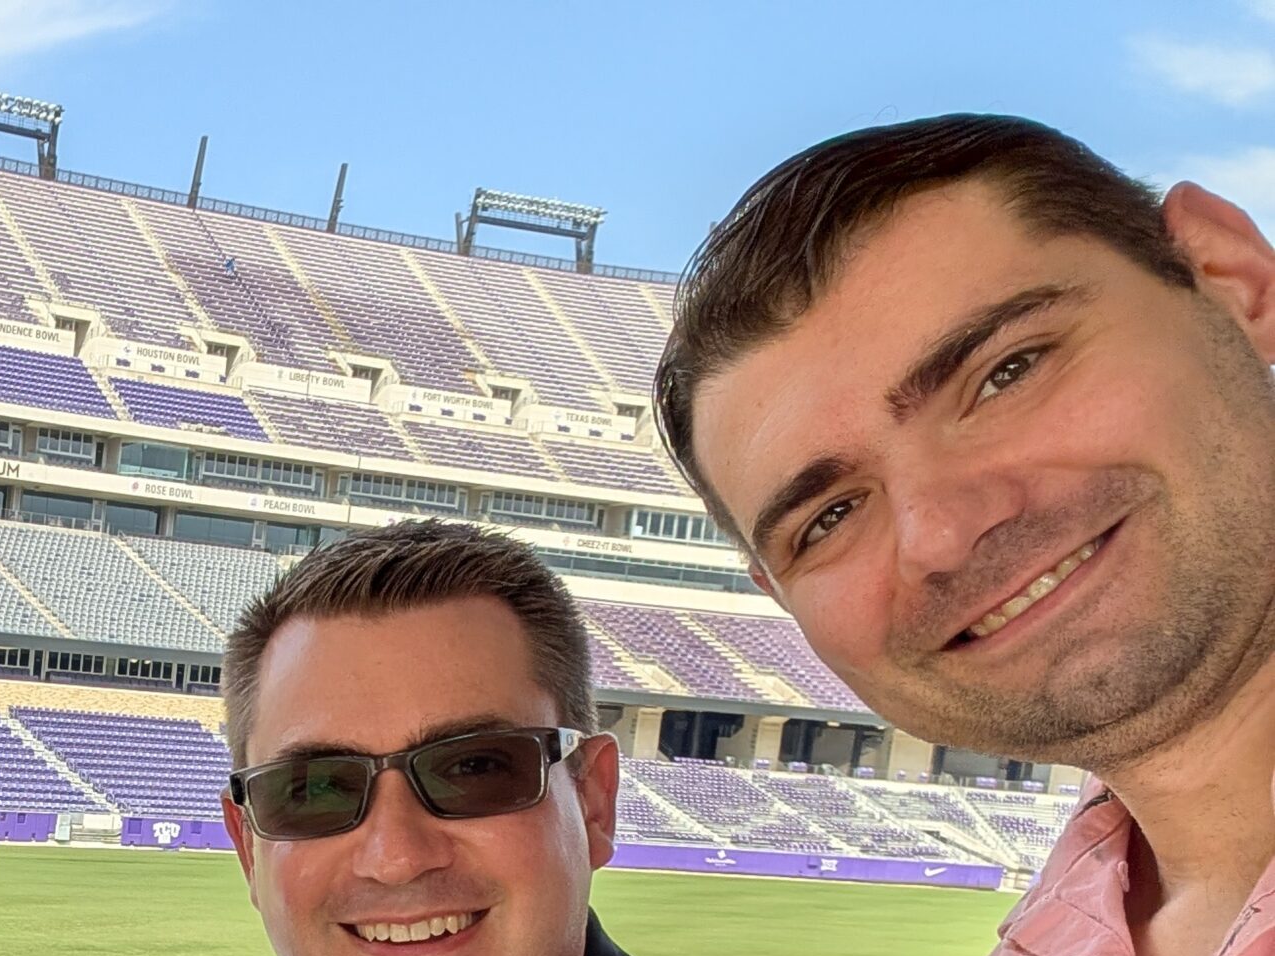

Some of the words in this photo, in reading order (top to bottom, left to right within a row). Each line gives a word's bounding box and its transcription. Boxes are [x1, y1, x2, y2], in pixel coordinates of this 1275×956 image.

[35, 329, 61, 342] BOWL
[136, 346, 175, 361] HOUSTON
[176, 353, 200, 366] BOWL
[289, 371, 320, 384] LIBERTY
[322, 377, 345, 389] BOWL
[472, 399, 494, 410] BOWL
[591, 416, 613, 427] BOWL
[145, 483, 167, 496] ROSE
[169, 487, 194, 500] BOWL
[263, 499, 291, 512] PEACH
[292, 503, 316, 515] BOWL
[611, 542, 634, 554] BOWL
[152, 821, 181, 844] TCU
